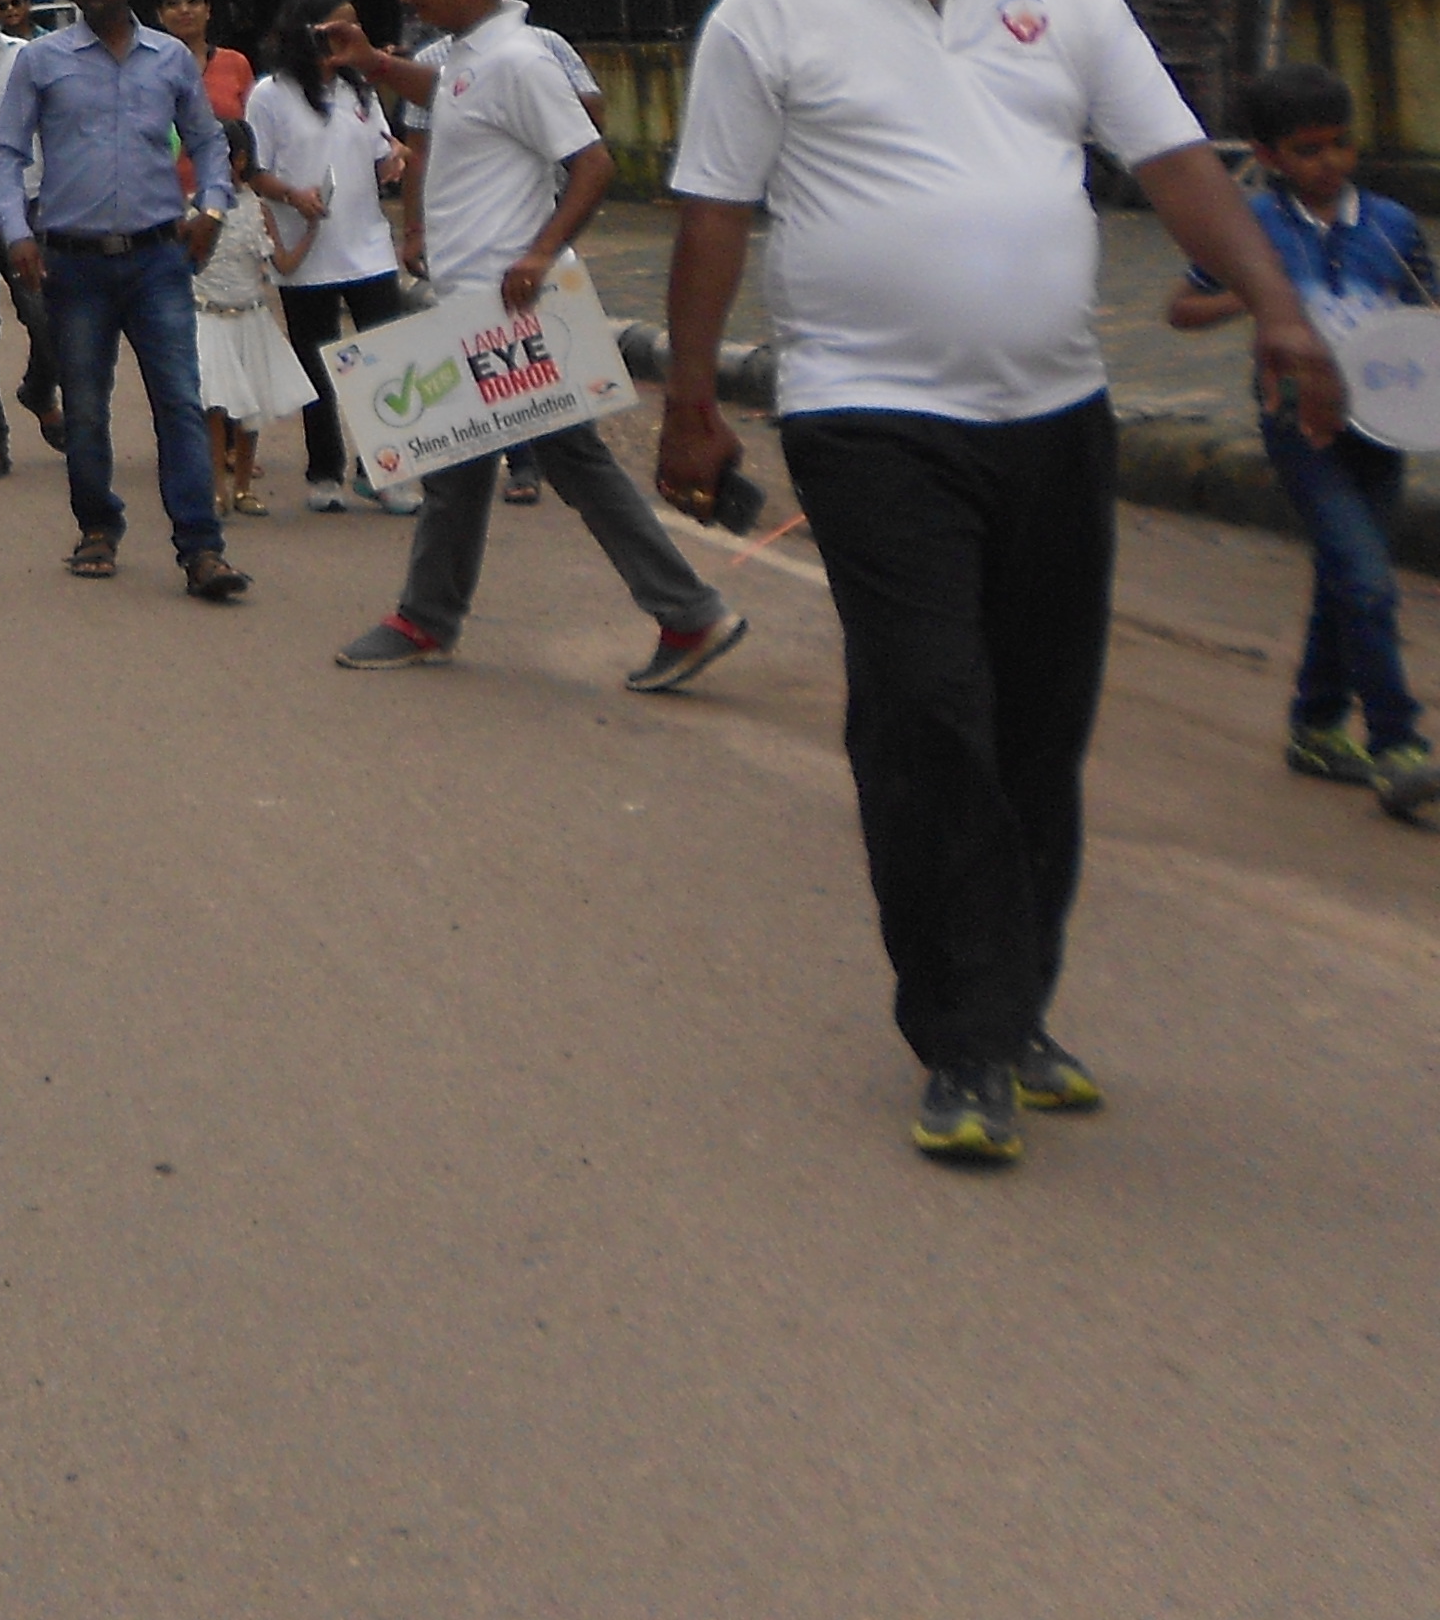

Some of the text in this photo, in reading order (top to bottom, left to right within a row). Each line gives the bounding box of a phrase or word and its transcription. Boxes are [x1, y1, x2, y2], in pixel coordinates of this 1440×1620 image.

[474, 325, 508, 351] AM
[512, 312, 544, 340] AN
[467, 333, 553, 381] EYE
[477, 359, 561, 406] DONOR
[408, 391, 577, 460] Shine India Foundation
